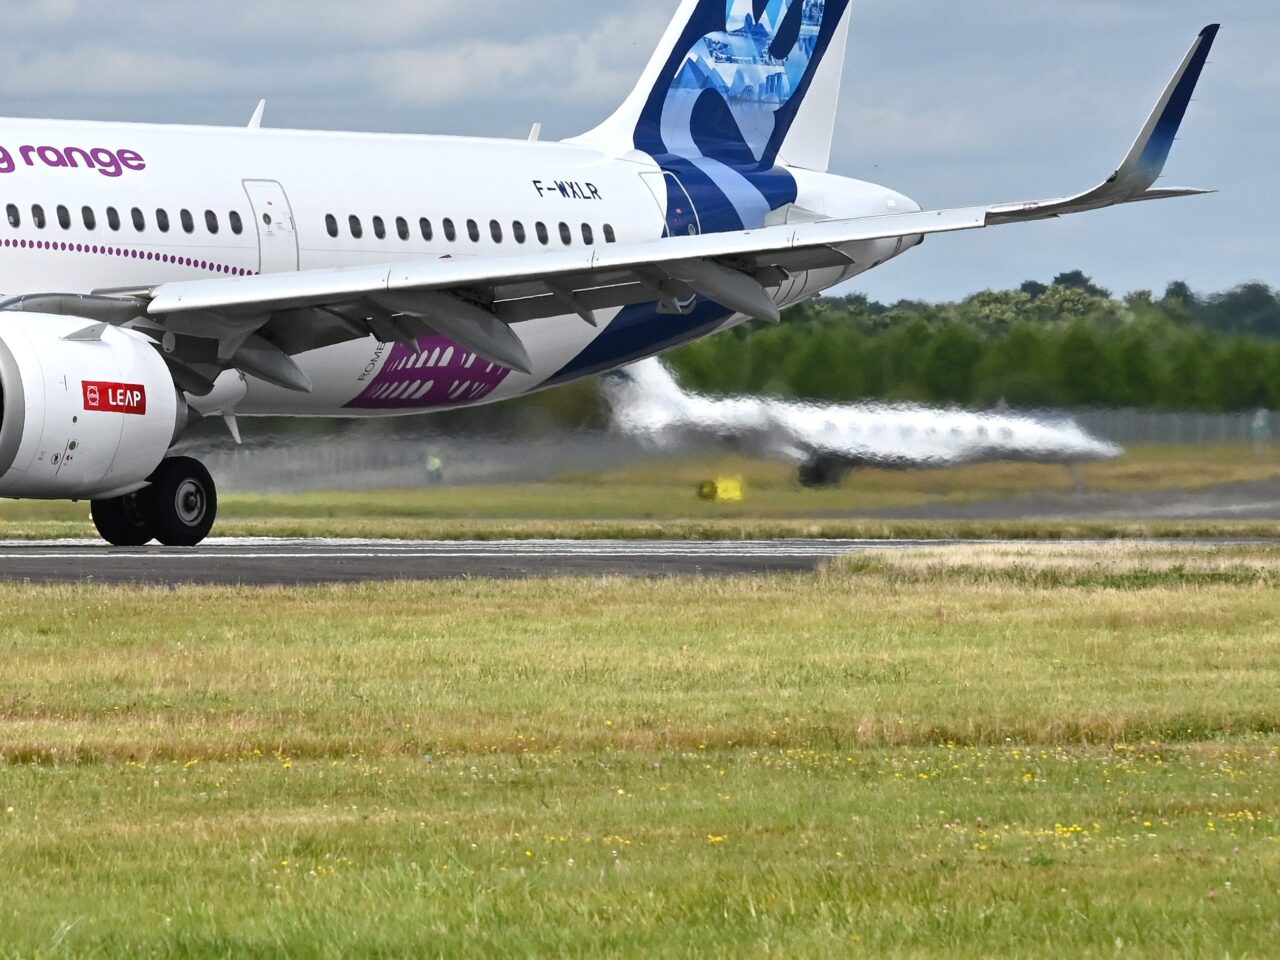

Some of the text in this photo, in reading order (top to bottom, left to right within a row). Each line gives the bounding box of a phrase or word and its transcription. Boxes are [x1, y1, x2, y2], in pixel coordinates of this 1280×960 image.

[19, 145, 146, 177] range
[532, 179, 602, 200] F-WXLR
[357, 341, 386, 381] ROME
[108, 388, 141, 407] LEAP
